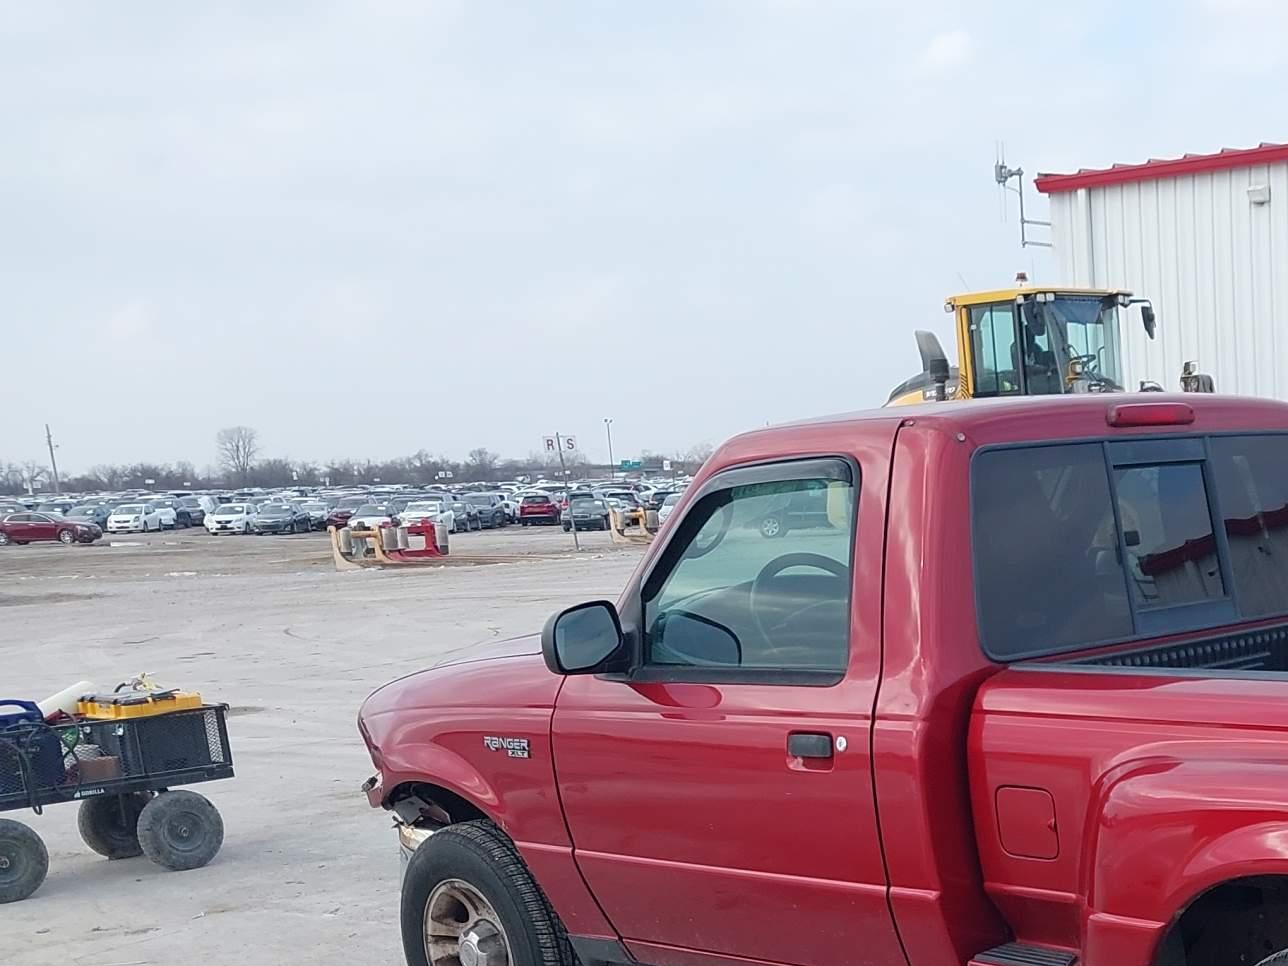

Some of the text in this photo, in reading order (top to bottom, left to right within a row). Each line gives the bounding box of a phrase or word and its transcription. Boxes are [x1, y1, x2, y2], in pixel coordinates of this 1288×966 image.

[546, 439, 555, 450] R
[566, 438, 575, 449] S
[484, 736, 529, 751] RANGER
[509, 750, 528, 758] XLT
